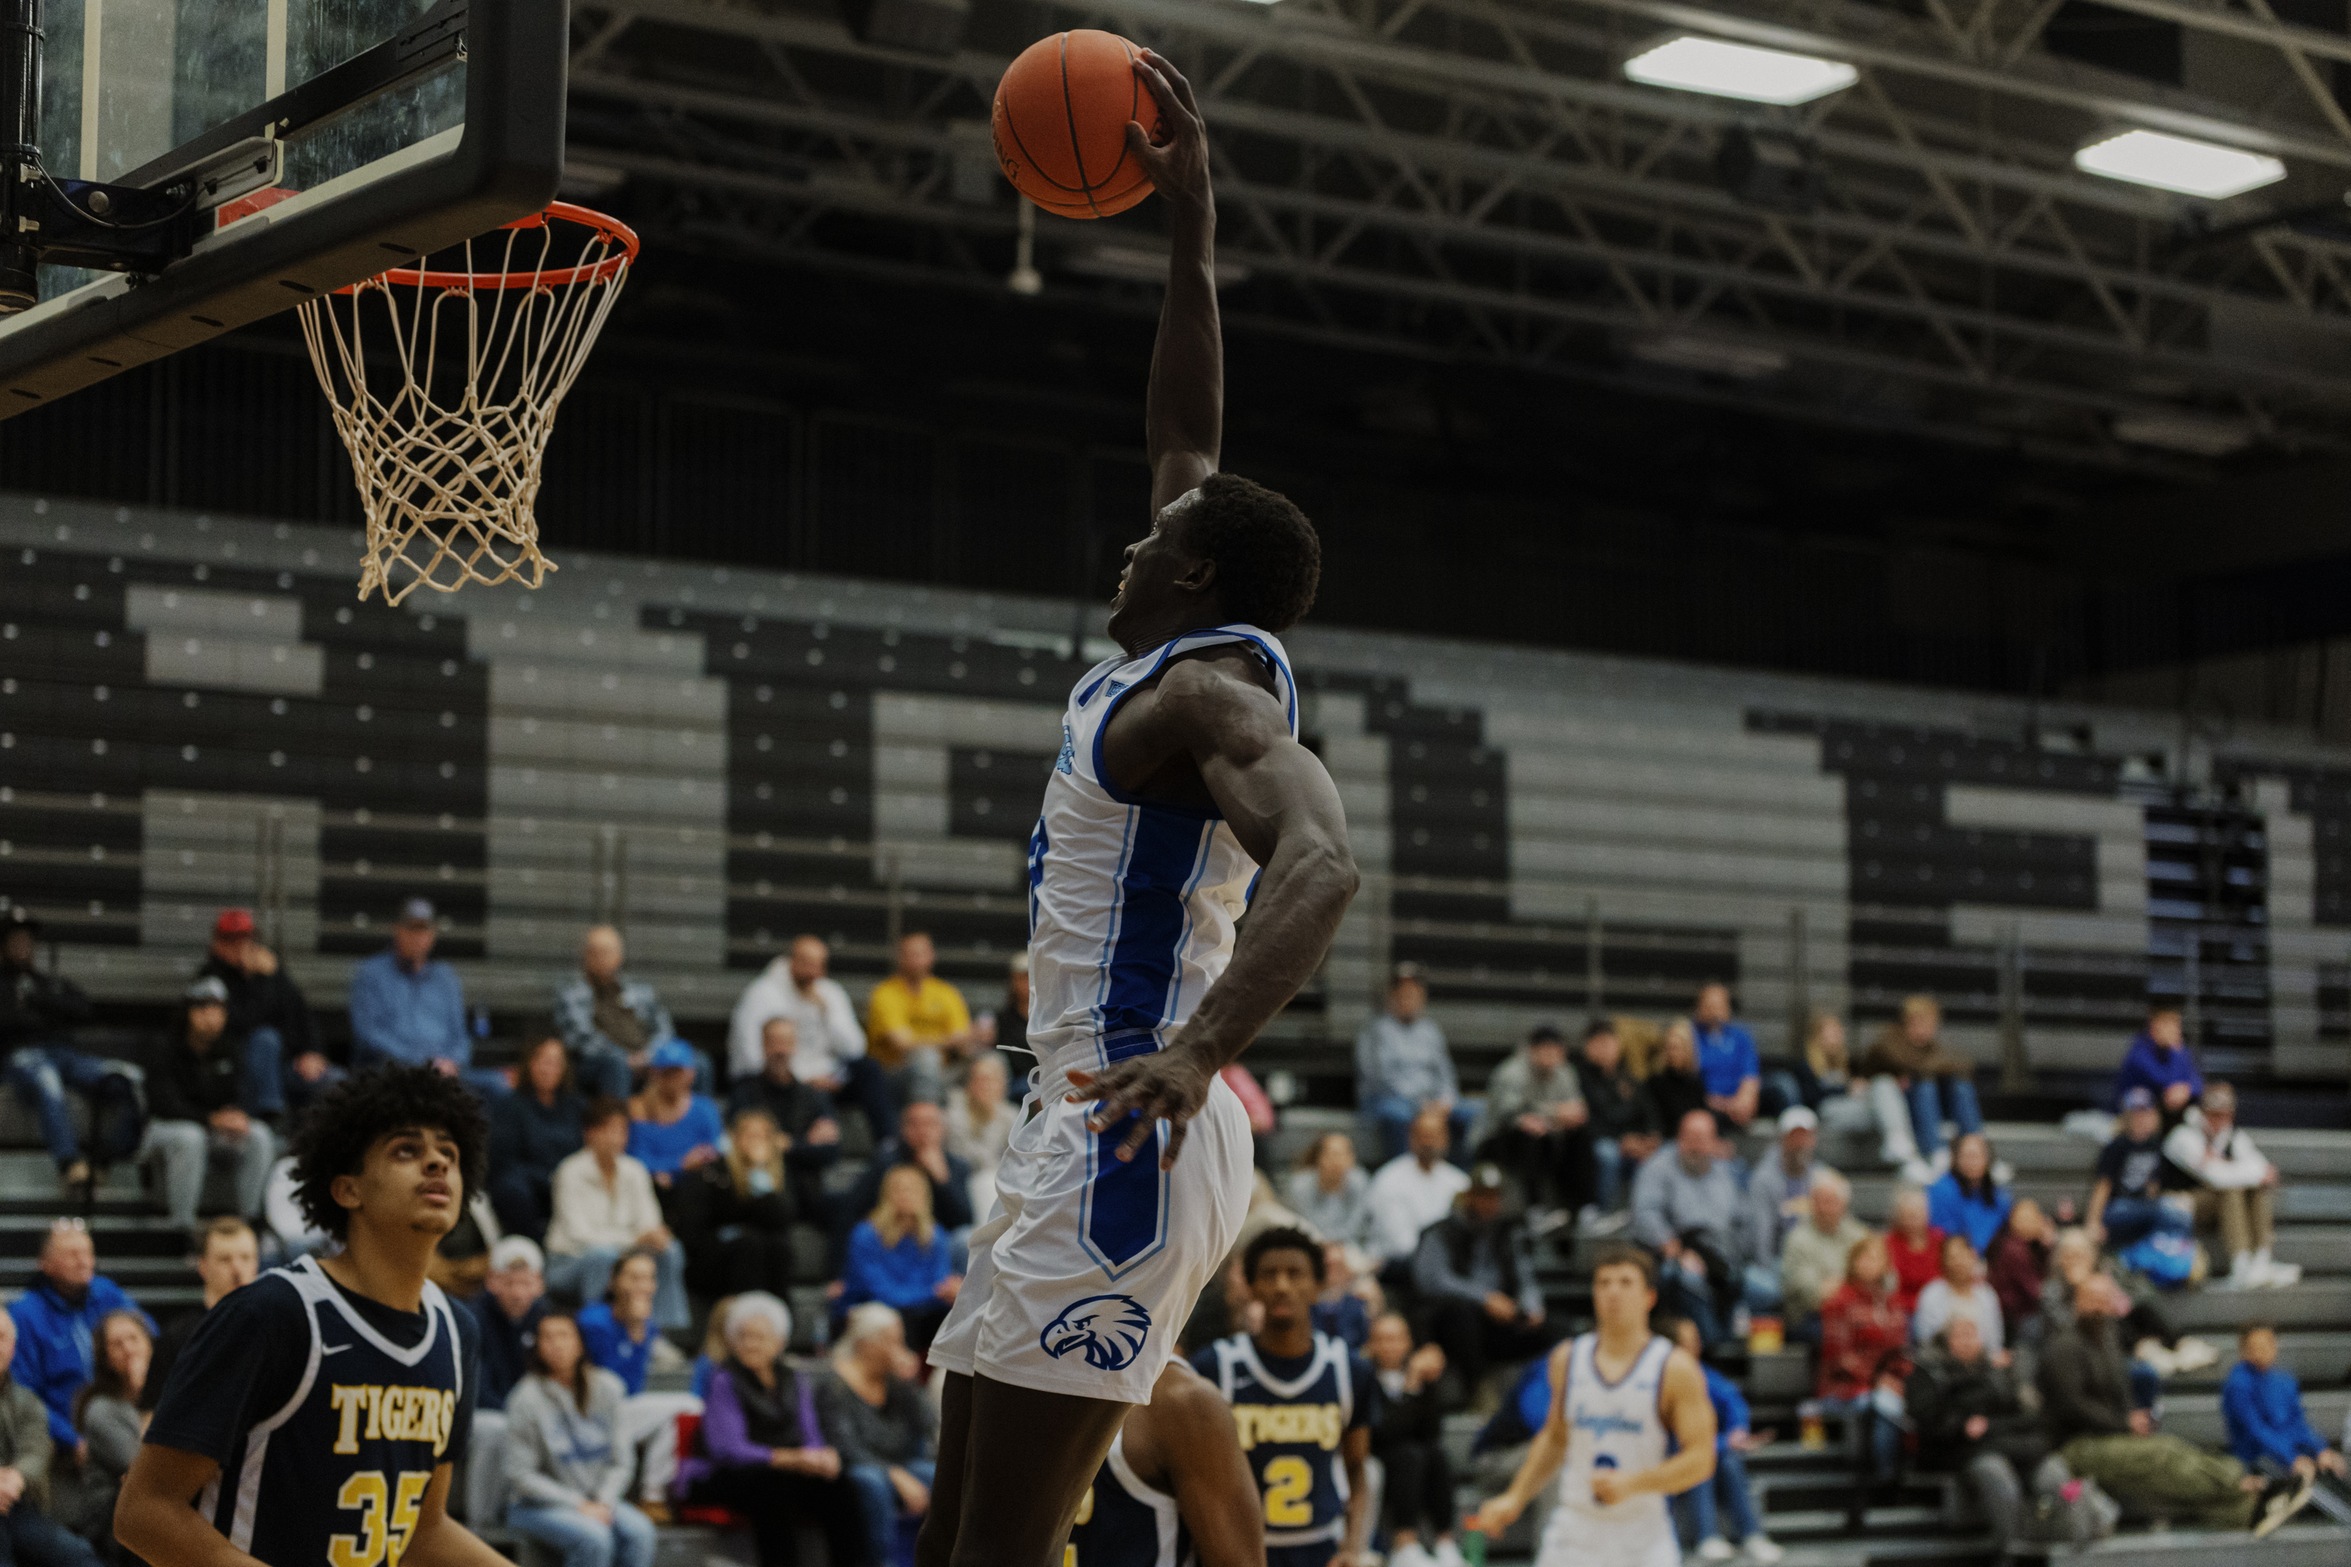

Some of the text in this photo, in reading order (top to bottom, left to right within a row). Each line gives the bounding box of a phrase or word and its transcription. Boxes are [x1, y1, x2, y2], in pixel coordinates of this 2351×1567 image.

[330, 1384, 455, 1458] TIGERS
[1232, 1402, 1341, 1450] TIGERS
[327, 1470, 432, 1567] 35
[1263, 1455, 1314, 1527] 2
